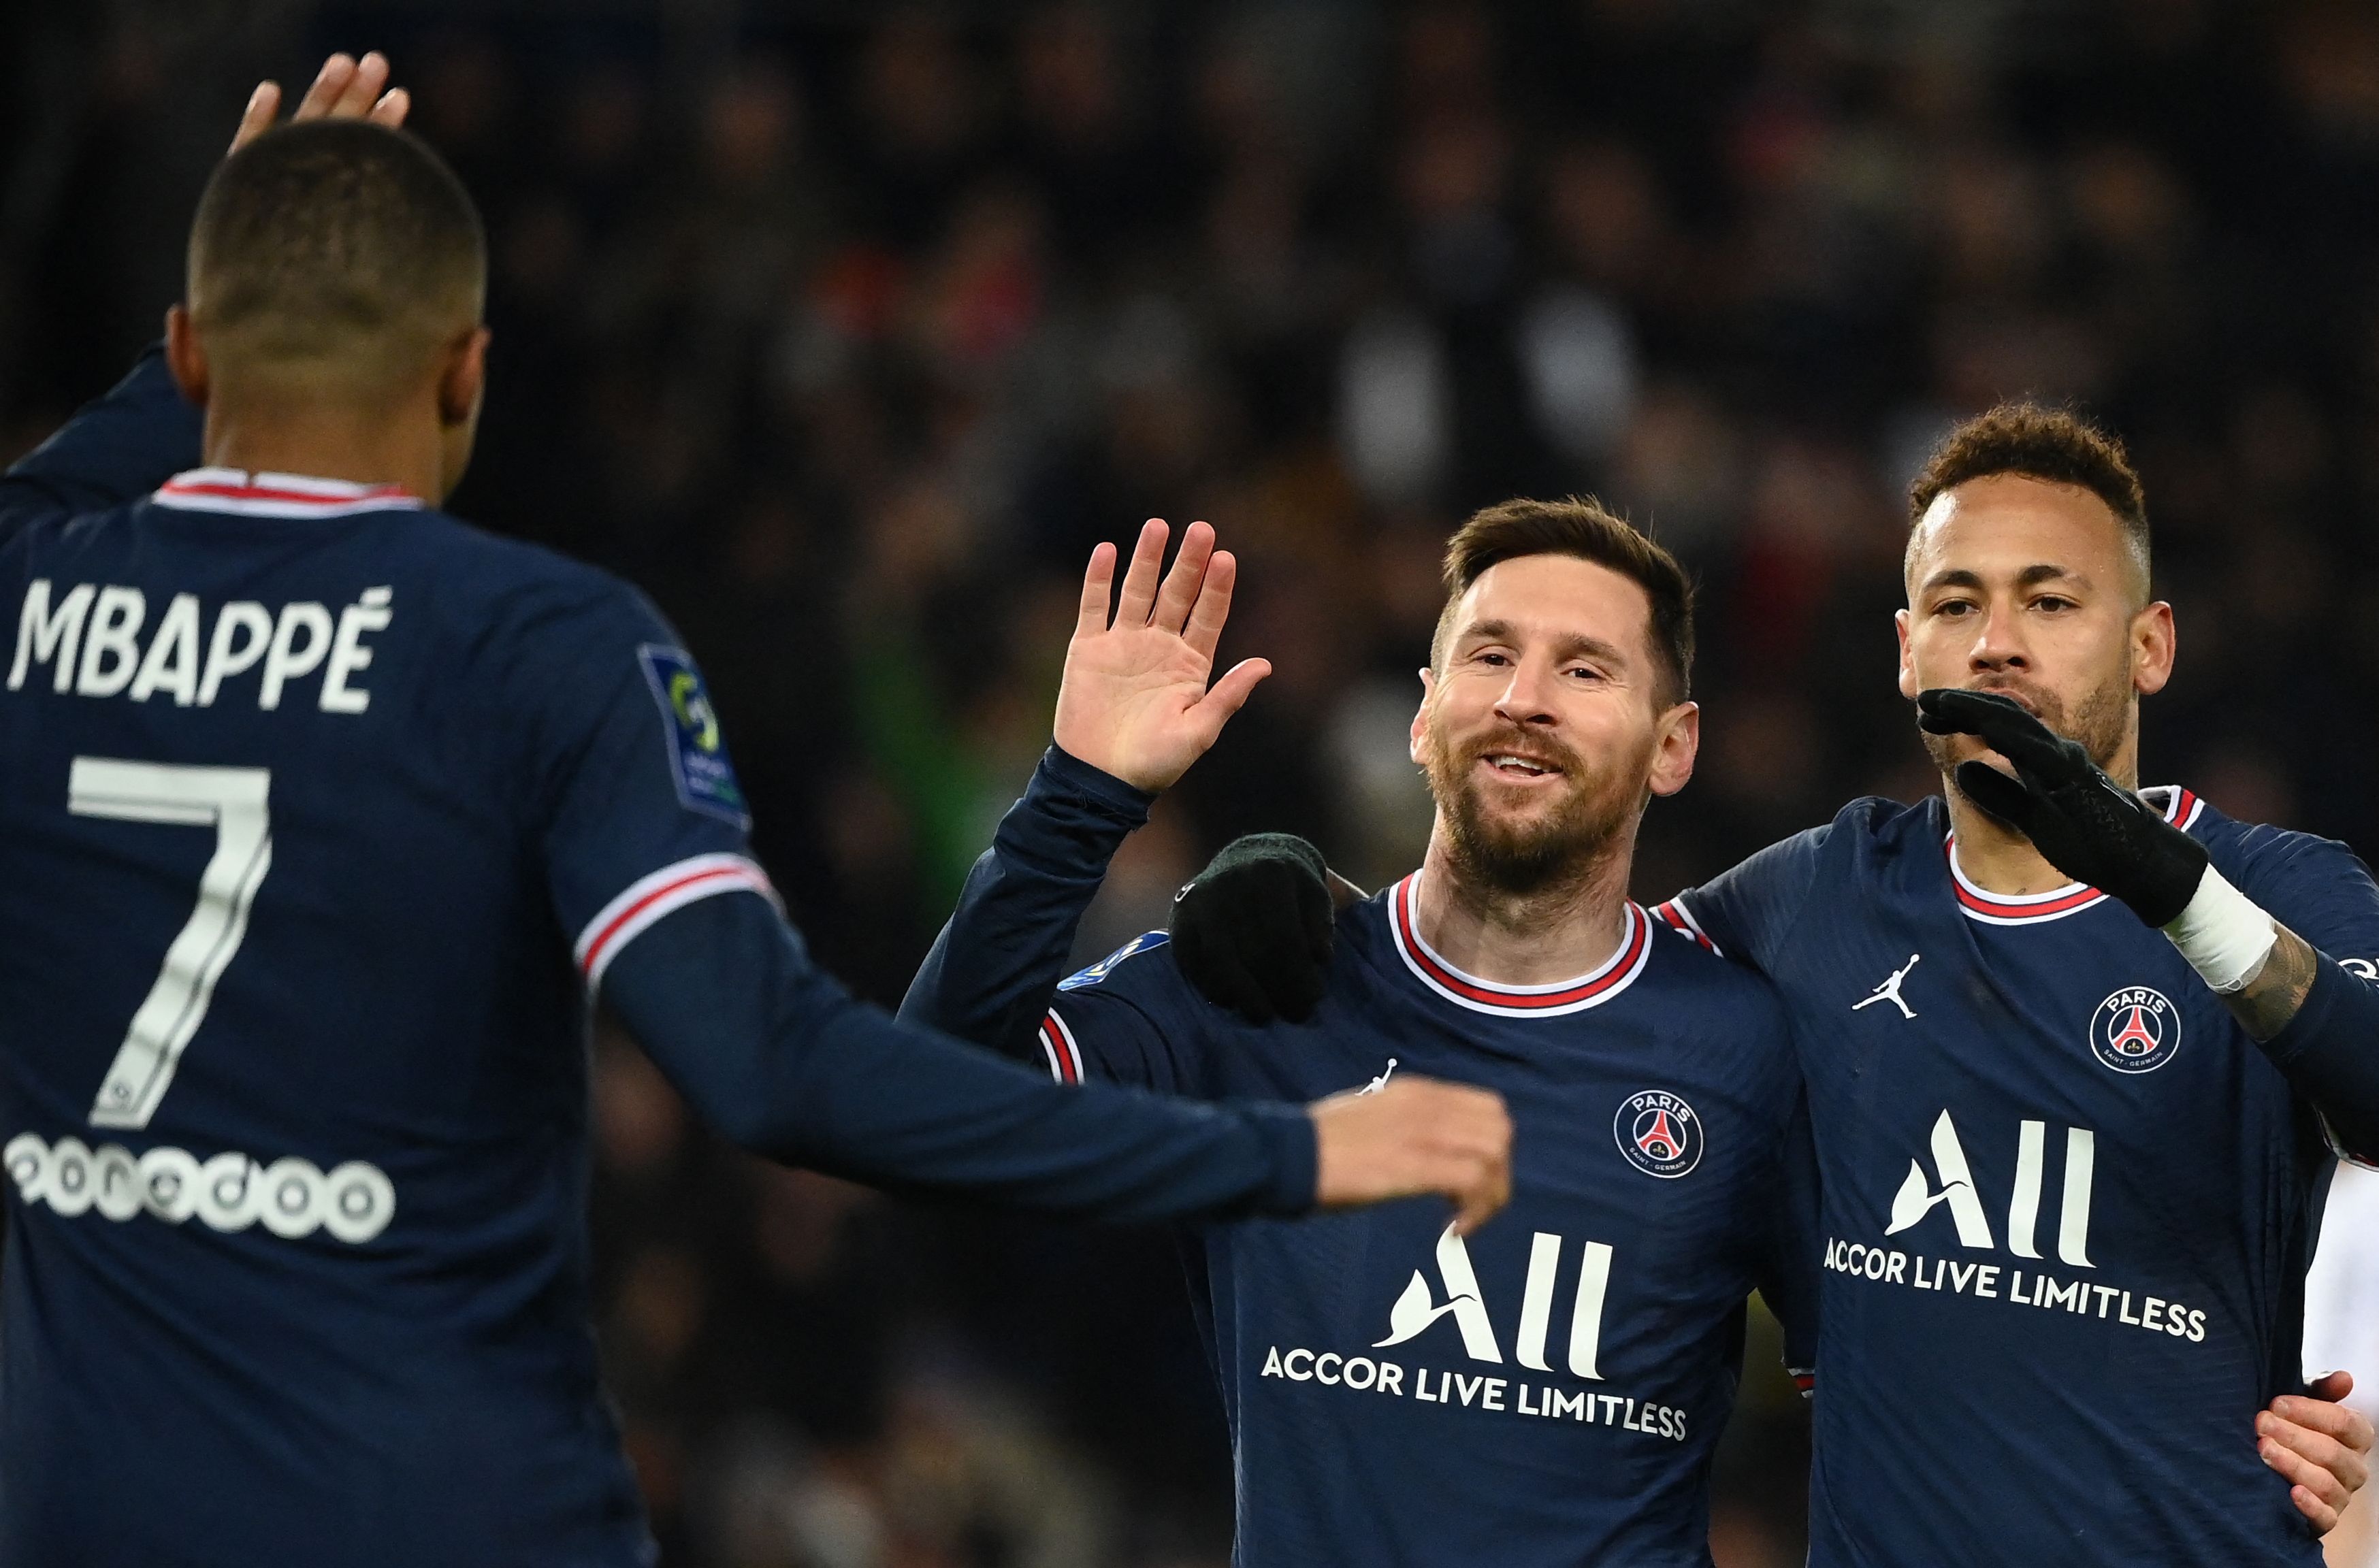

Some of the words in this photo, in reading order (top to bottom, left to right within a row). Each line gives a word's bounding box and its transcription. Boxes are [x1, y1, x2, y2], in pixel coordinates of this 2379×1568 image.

[7, 578, 393, 715] MBAPPÉ
[67, 755, 273, 1130] 7
[2107, 990, 2167, 1013] PARIS
[2129, 1051, 2163, 1066] GERMAIN
[1631, 1094, 1691, 1122] PARIS
[1824, 1236, 1906, 1284] ACCOR
[1913, 1256, 2001, 1298] LIVE
[2009, 1271, 2206, 1343] LIMITLESS
[1261, 1345, 1404, 1396] ACCOR
[1415, 1368, 1508, 1411] LIVE
[1517, 1384, 1687, 1441] LIMITLESS
